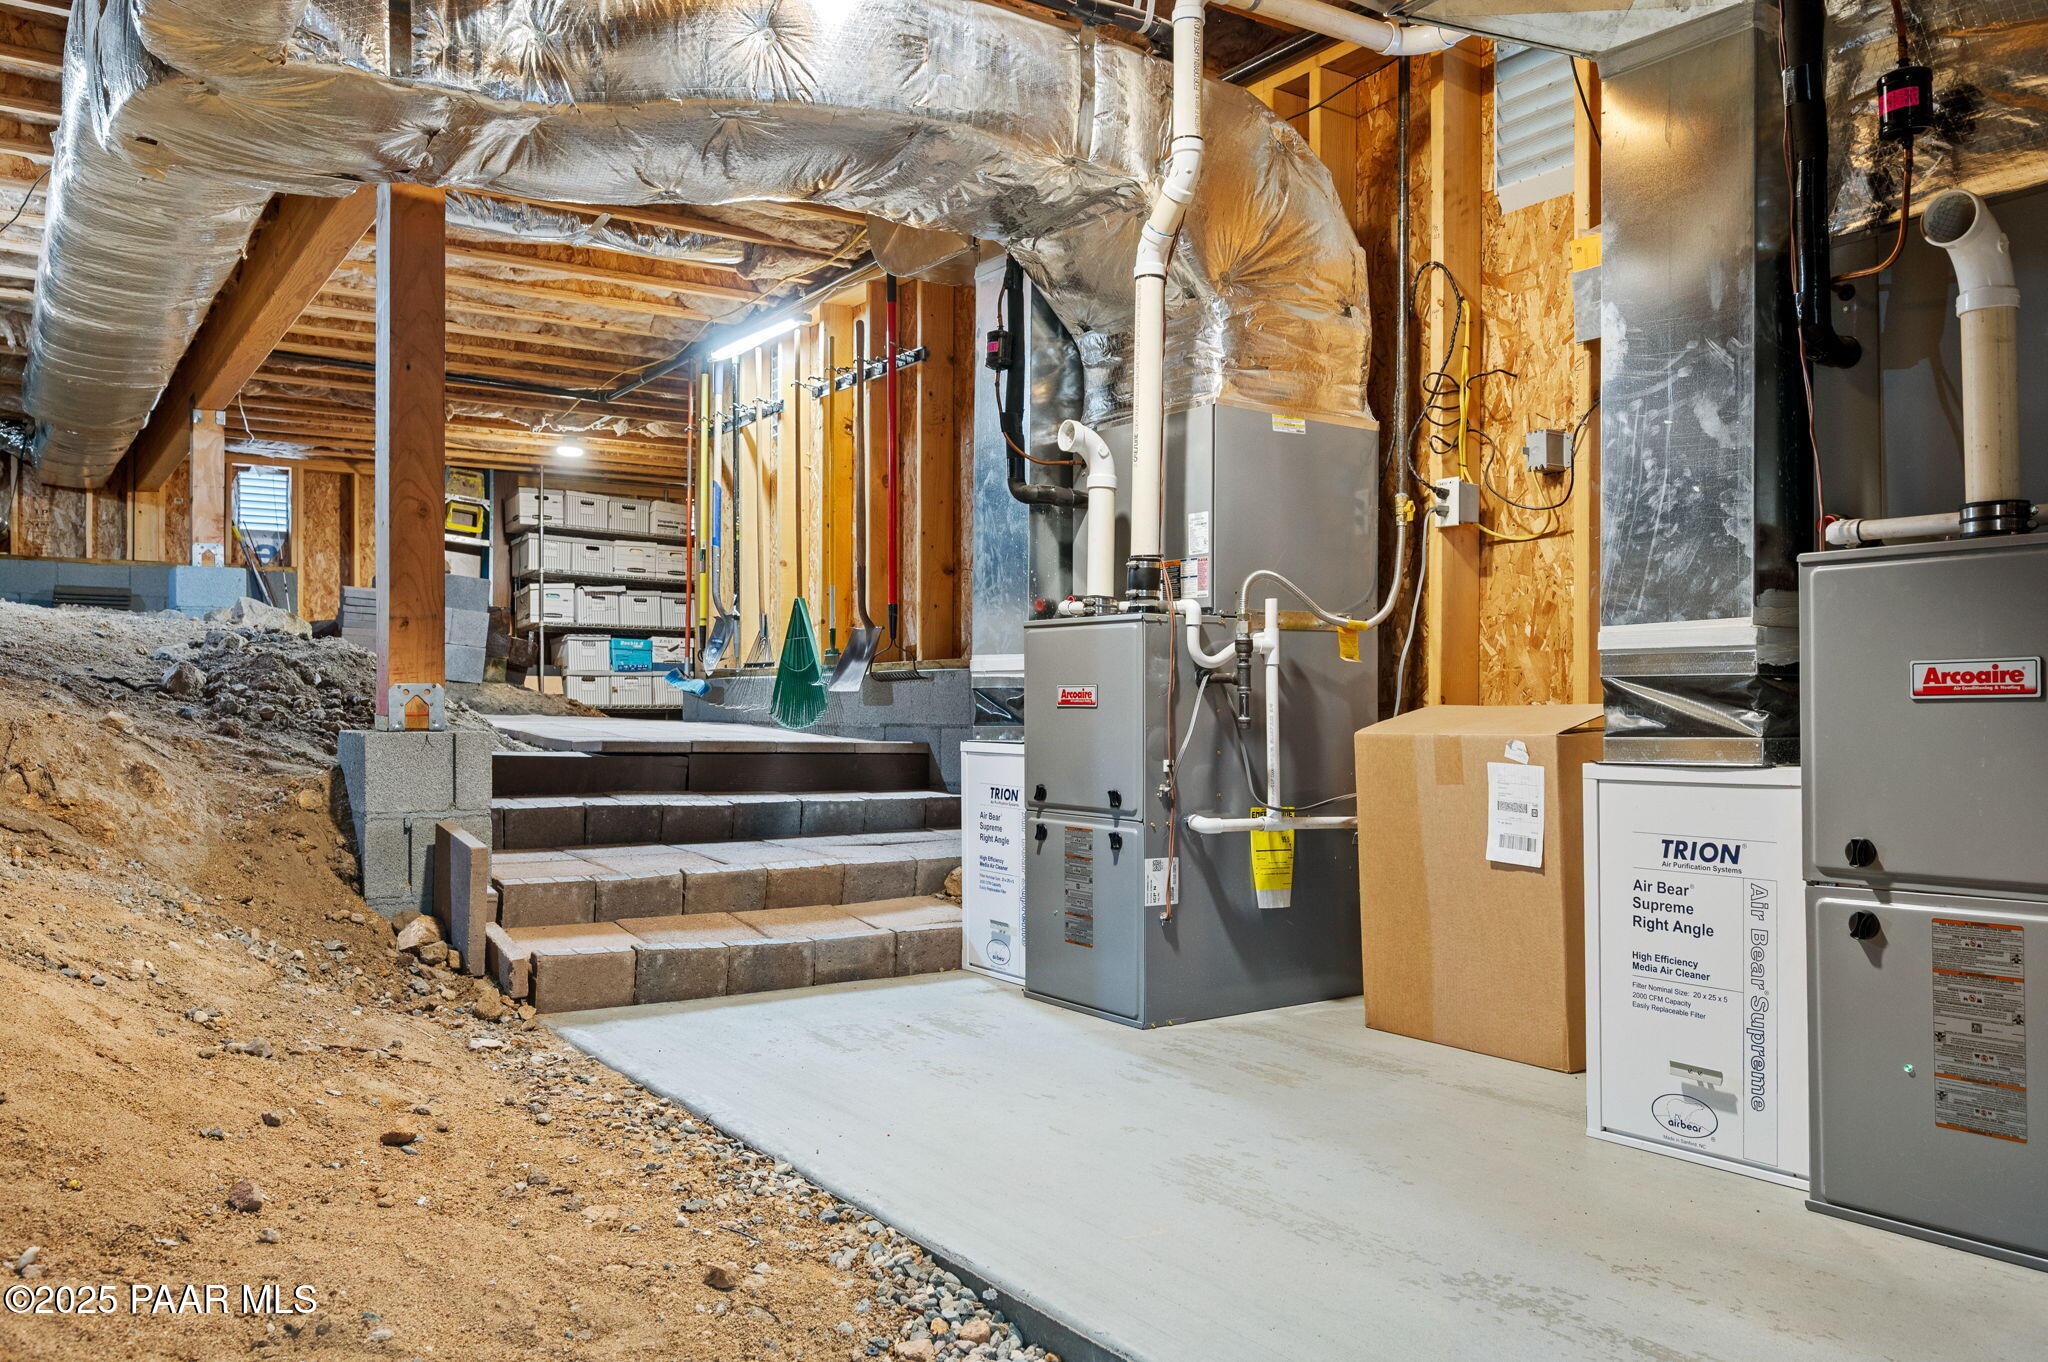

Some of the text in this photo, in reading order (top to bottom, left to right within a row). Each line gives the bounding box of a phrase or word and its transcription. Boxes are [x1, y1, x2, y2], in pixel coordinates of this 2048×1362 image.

[1923, 664, 2025, 684] Arcoaire
[1061, 688, 1092, 699] Arcoaire
[990, 787, 1019, 802] TRION
[979, 812, 1001, 822] Air Bear
[979, 822, 1003, 833] Supreme
[979, 834, 1010, 847] Right Angle
[1673, 862, 1711, 872] Purification
[1712, 865, 1743, 875] Systems
[1633, 879, 1653, 893] Air
[1632, 896, 1694, 915] Supreme
[1750, 882, 1769, 921] Air
[1632, 915, 1715, 939] Right Angle
[1632, 950, 1699, 970] High Efficiency
[1632, 962, 1711, 982] Media Air Cleaner
[1632, 981, 1647, 991] Filter
[1648, 984, 1673, 995] Nominal
[1674, 988, 1690, 998] Size:
[1692, 991, 1702, 1000] 20
[1708, 993, 1717, 1002] 25
[1632, 991, 1692, 1009] 2000 CFM Capacity
[1632, 1000, 1707, 1021] Easily Replaceable Filter
[1746, 995, 1769, 1112] Supreme
[1668, 1118, 1702, 1134] airbear
